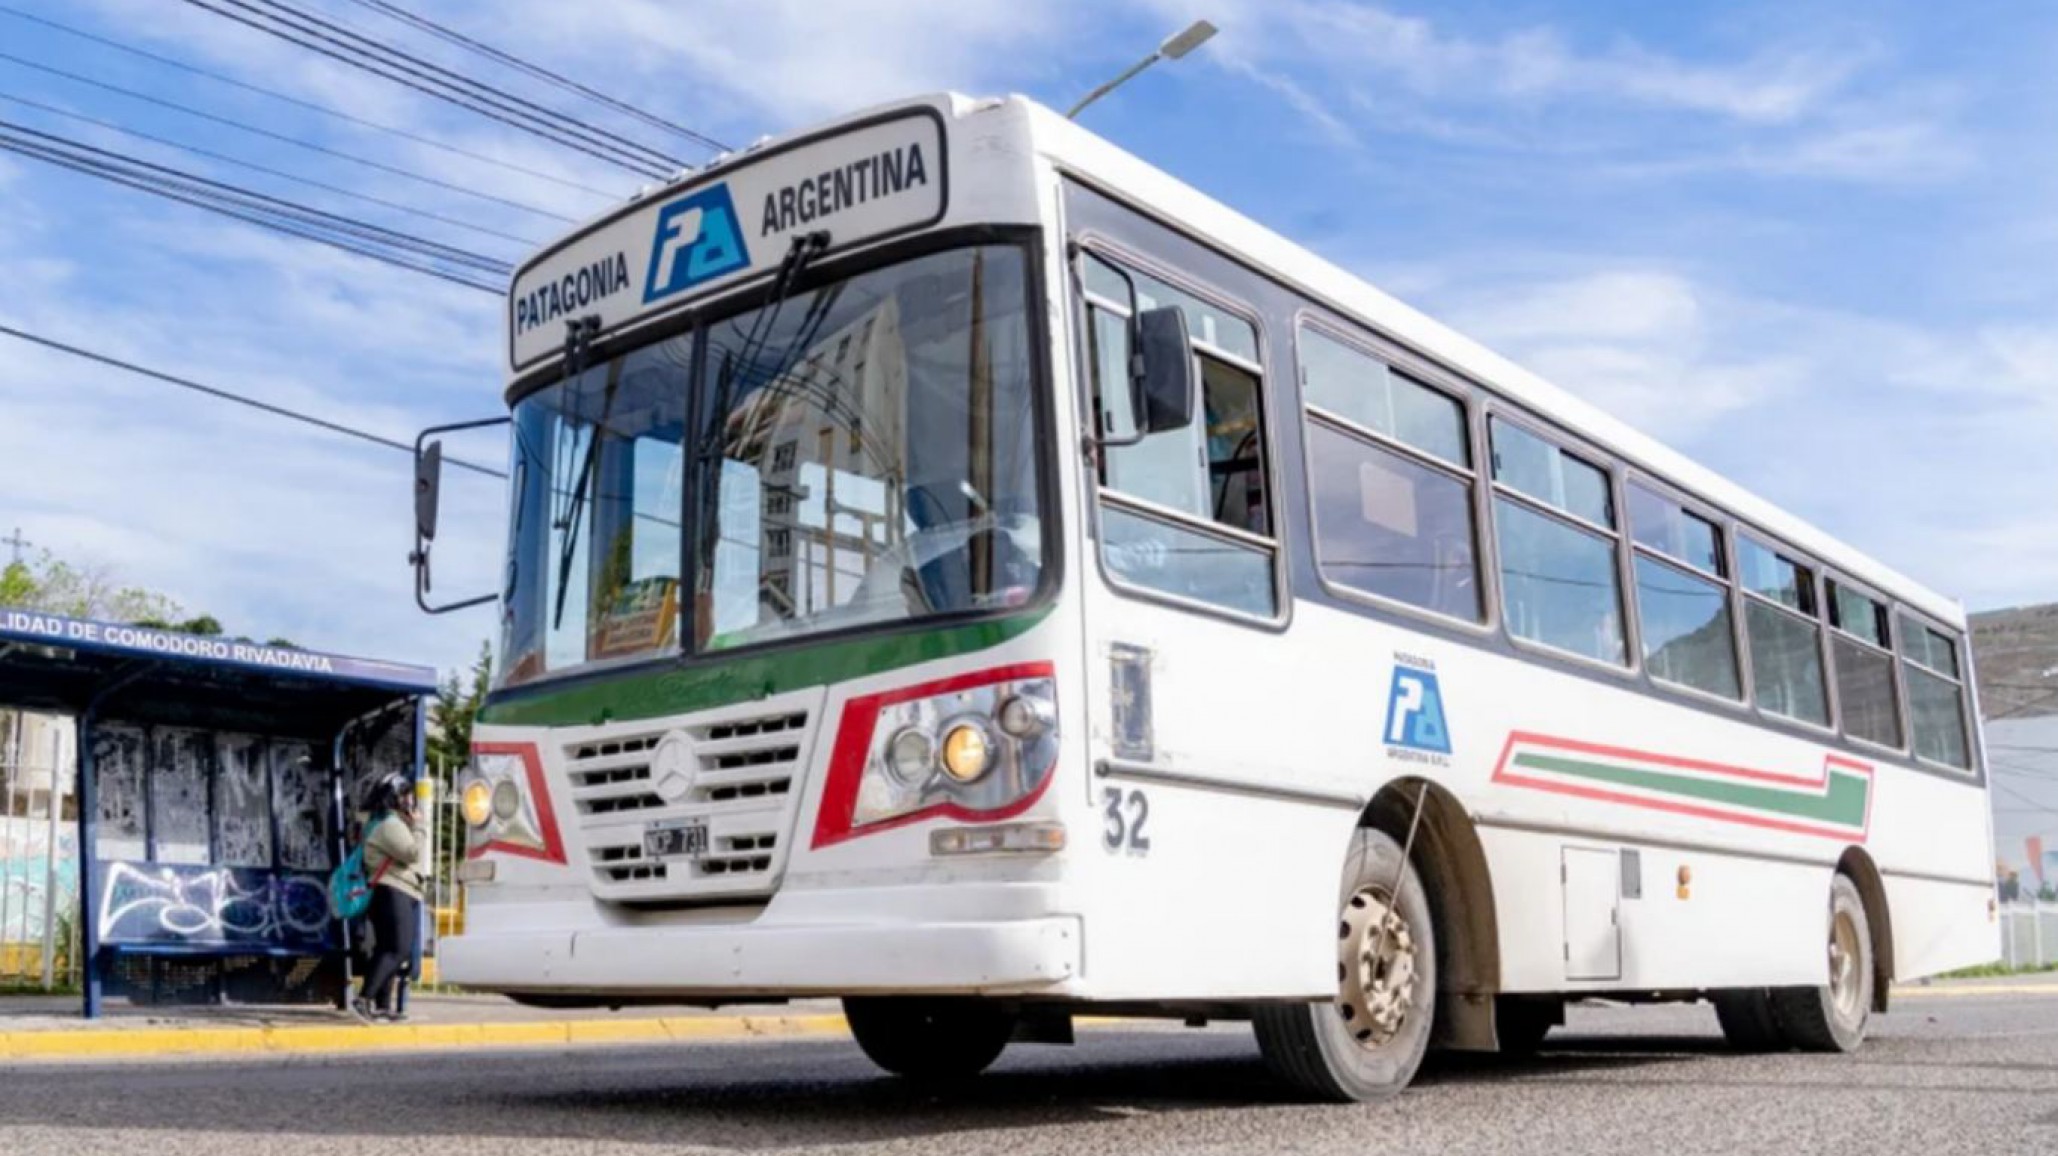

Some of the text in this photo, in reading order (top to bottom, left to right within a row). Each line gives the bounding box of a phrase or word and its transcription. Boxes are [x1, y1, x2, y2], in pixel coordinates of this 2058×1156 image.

[516, 251, 630, 335] PATAGONIA
[761, 142, 927, 237] ARGENTINA
[69, 621, 97, 641] DE
[104, 626, 228, 659] COMODORO
[234, 644, 333, 672] RIVADAVIA
[1103, 786, 1150, 851] 32
